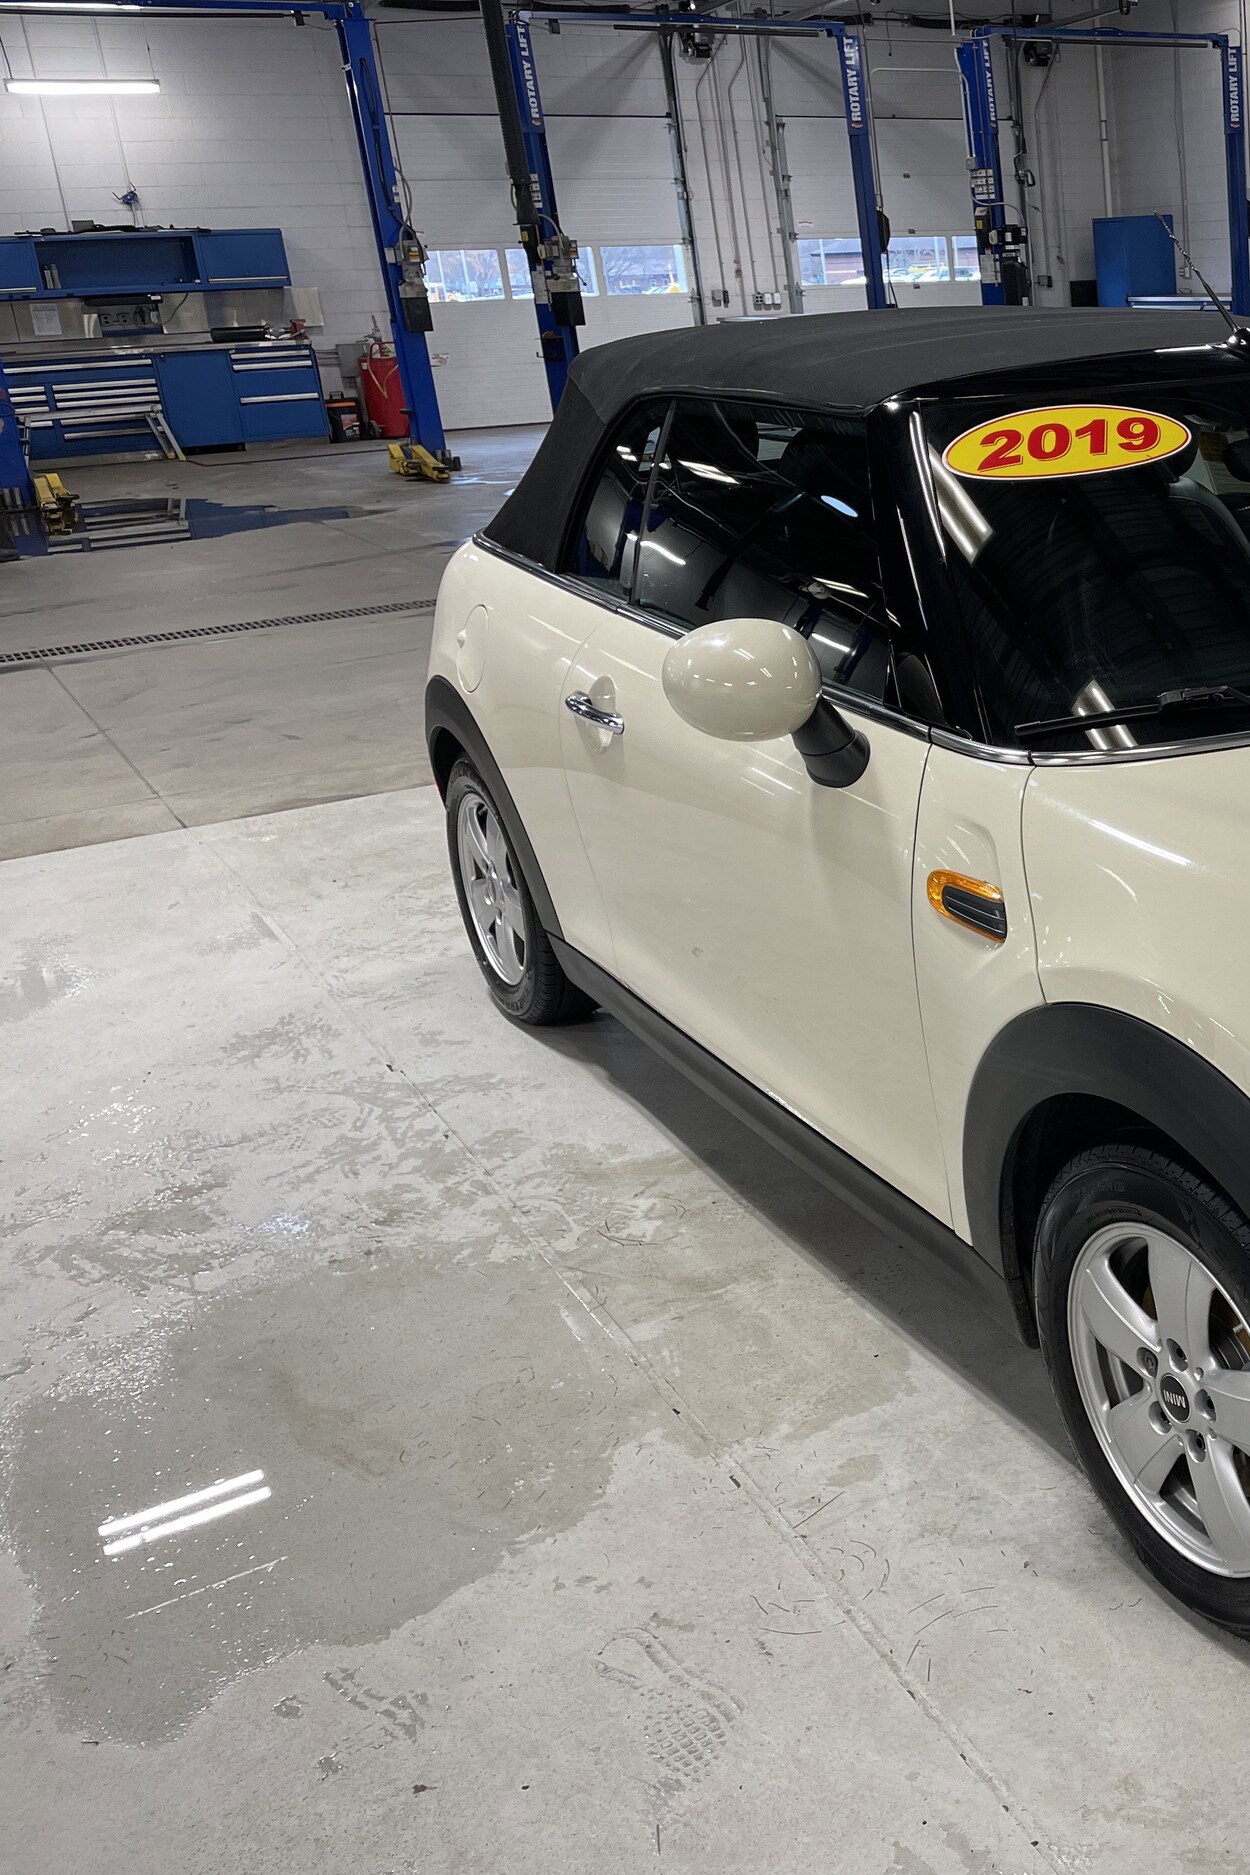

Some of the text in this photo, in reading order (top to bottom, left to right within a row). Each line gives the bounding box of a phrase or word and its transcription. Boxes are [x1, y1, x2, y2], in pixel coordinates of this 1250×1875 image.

[517, 25, 540, 119] ROTARY LIFT
[843, 36, 862, 122] ROTARY LIFT
[1227, 47, 1240, 122] ROTARY LIFT
[976, 416, 1162, 472] 2019
[1162, 1389, 1187, 1409] MINI
